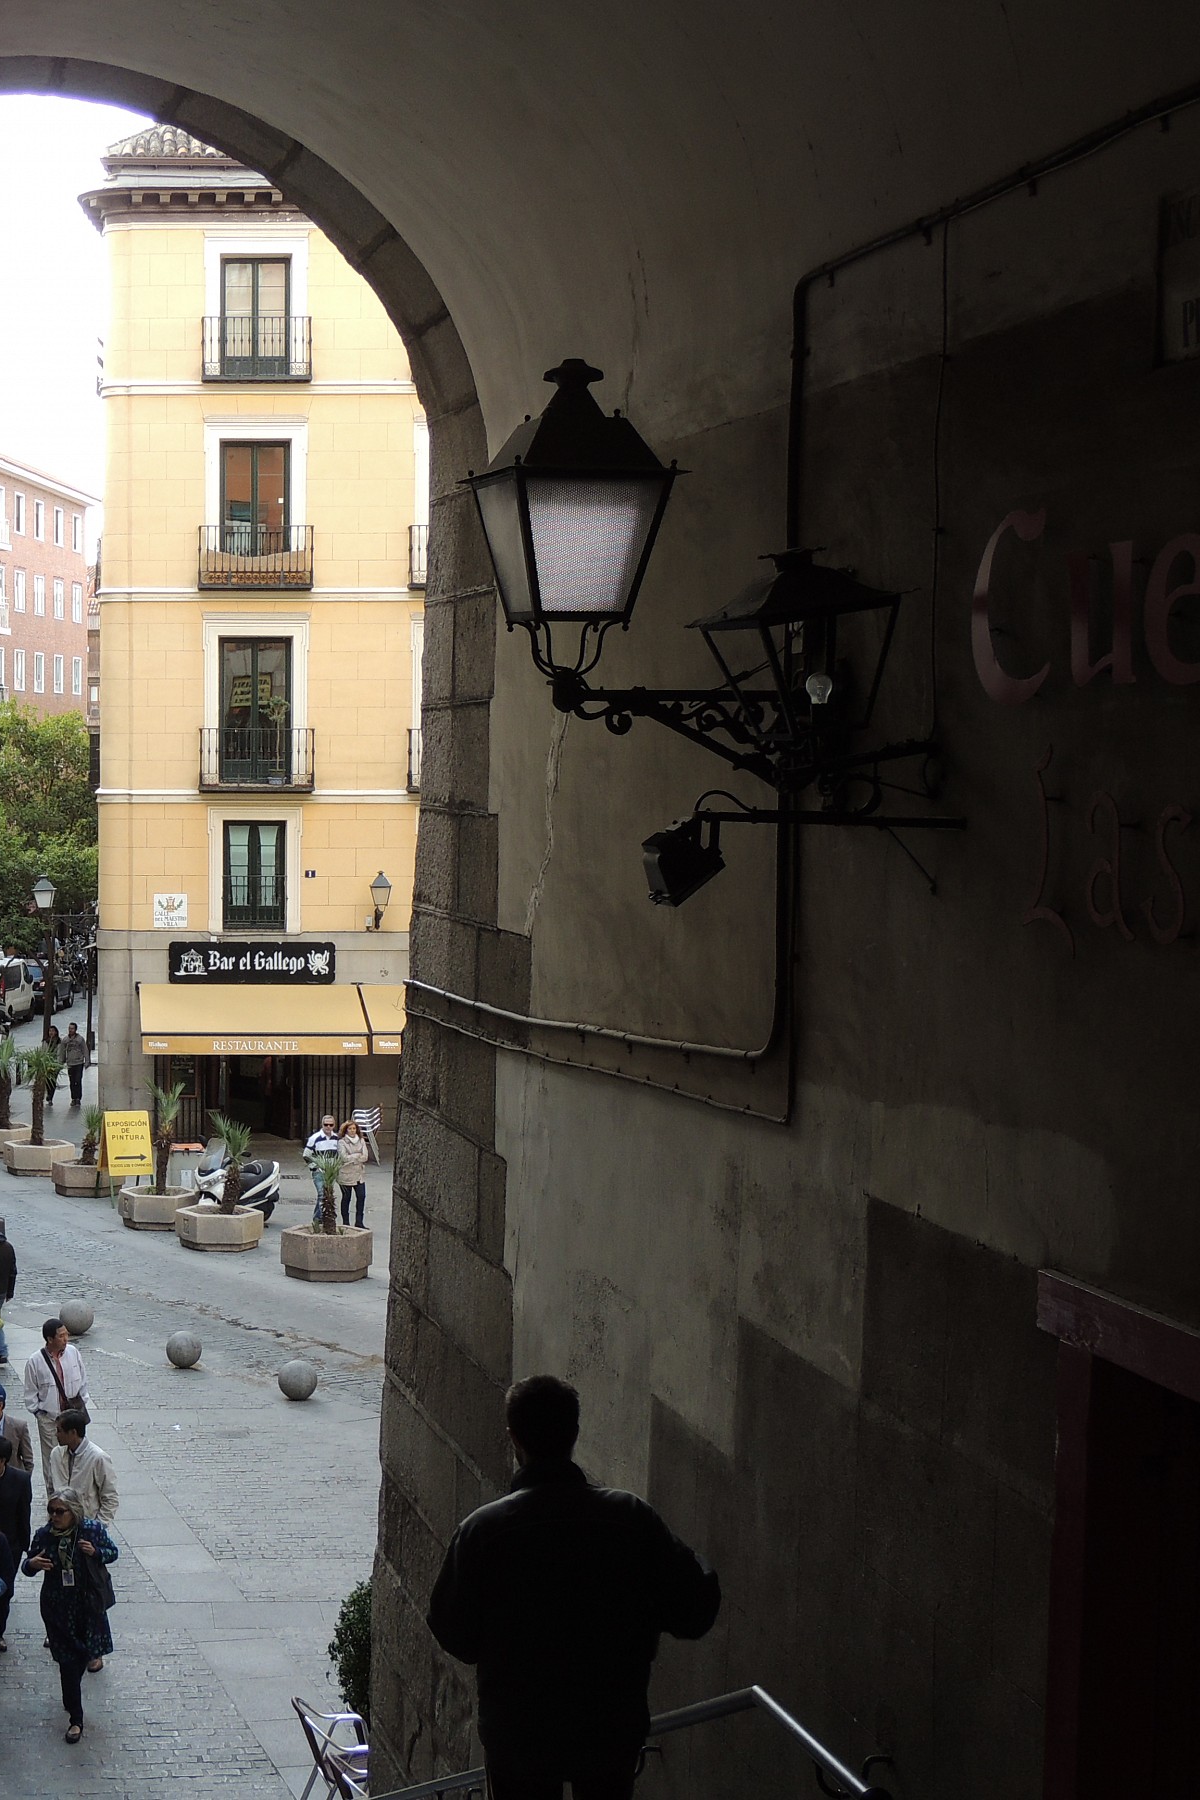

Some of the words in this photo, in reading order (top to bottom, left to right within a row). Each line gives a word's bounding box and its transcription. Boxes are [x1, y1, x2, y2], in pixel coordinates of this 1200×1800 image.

[207, 950, 235, 970] Bar
[239, 951, 251, 970] el
[253, 951, 305, 975] Gallego
[212, 1040, 299, 1051] RESTAURANTE
